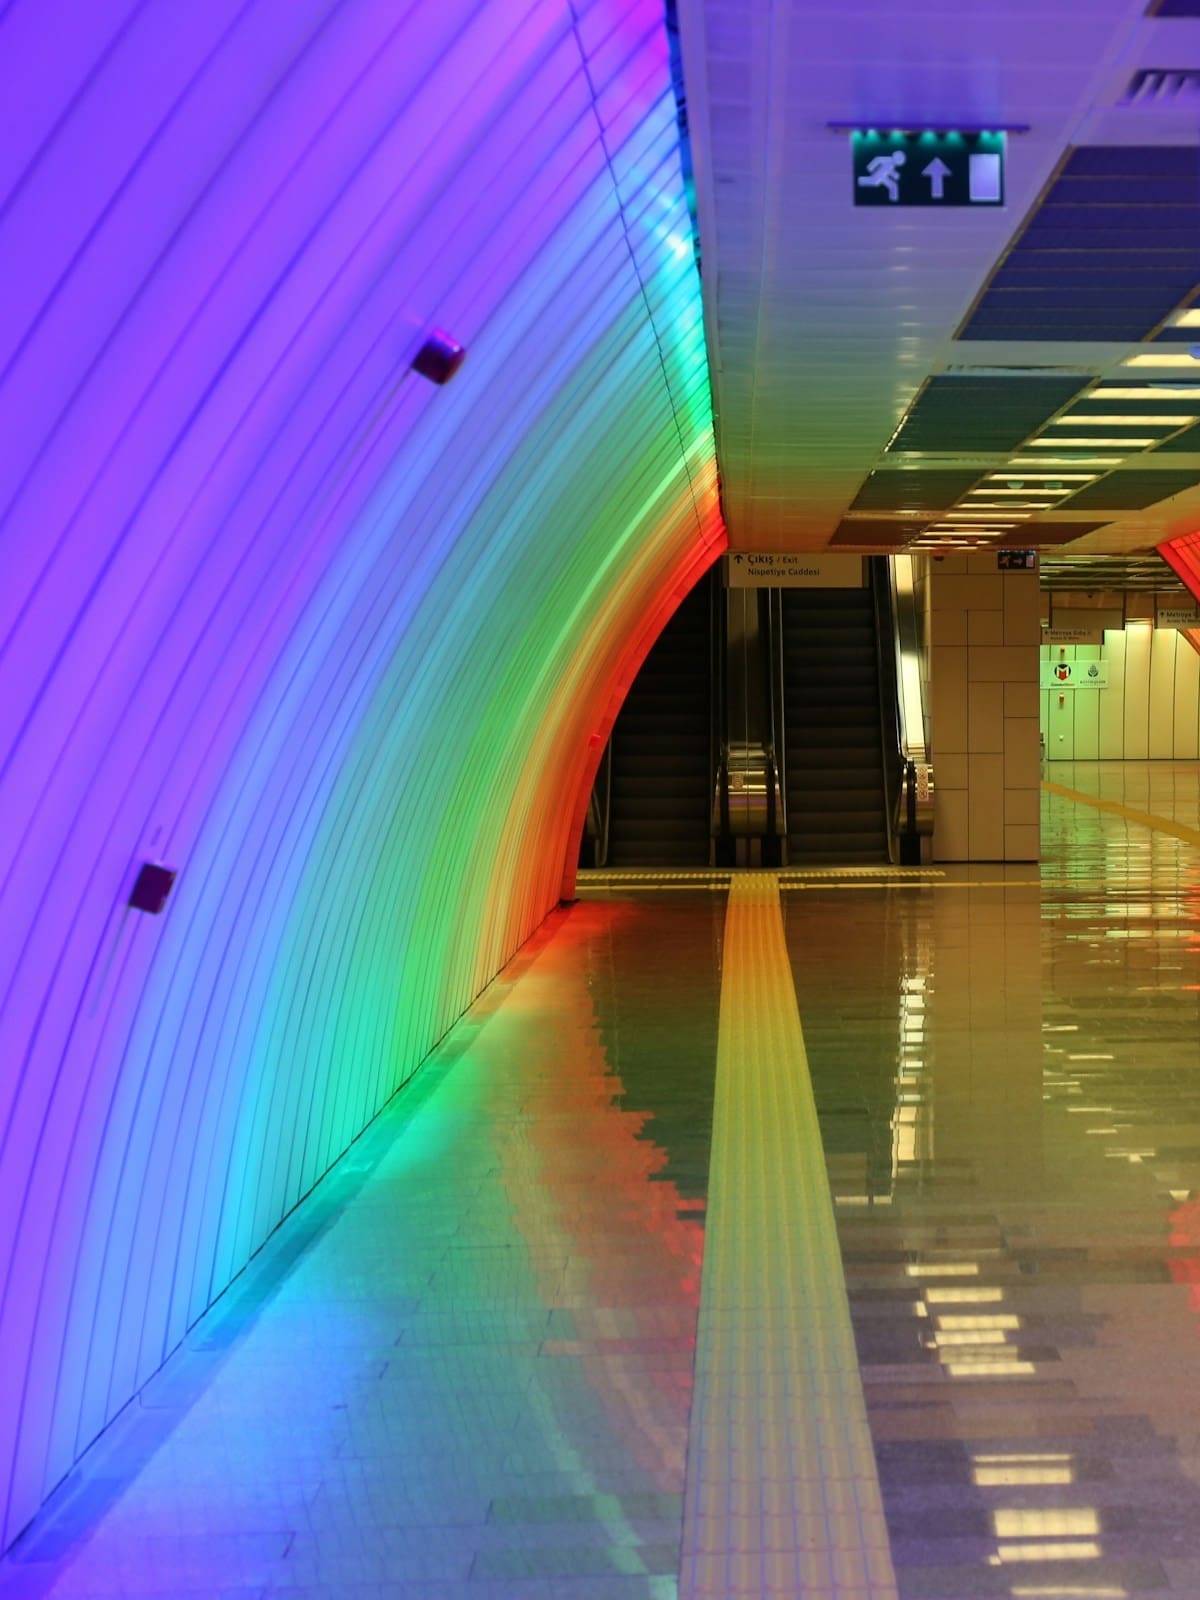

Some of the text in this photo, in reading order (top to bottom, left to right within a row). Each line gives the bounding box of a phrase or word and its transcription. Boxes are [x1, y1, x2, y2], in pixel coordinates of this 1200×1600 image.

[782, 556, 798, 564] Exit
[748, 567, 820, 577] Nispetiye Caddesi
